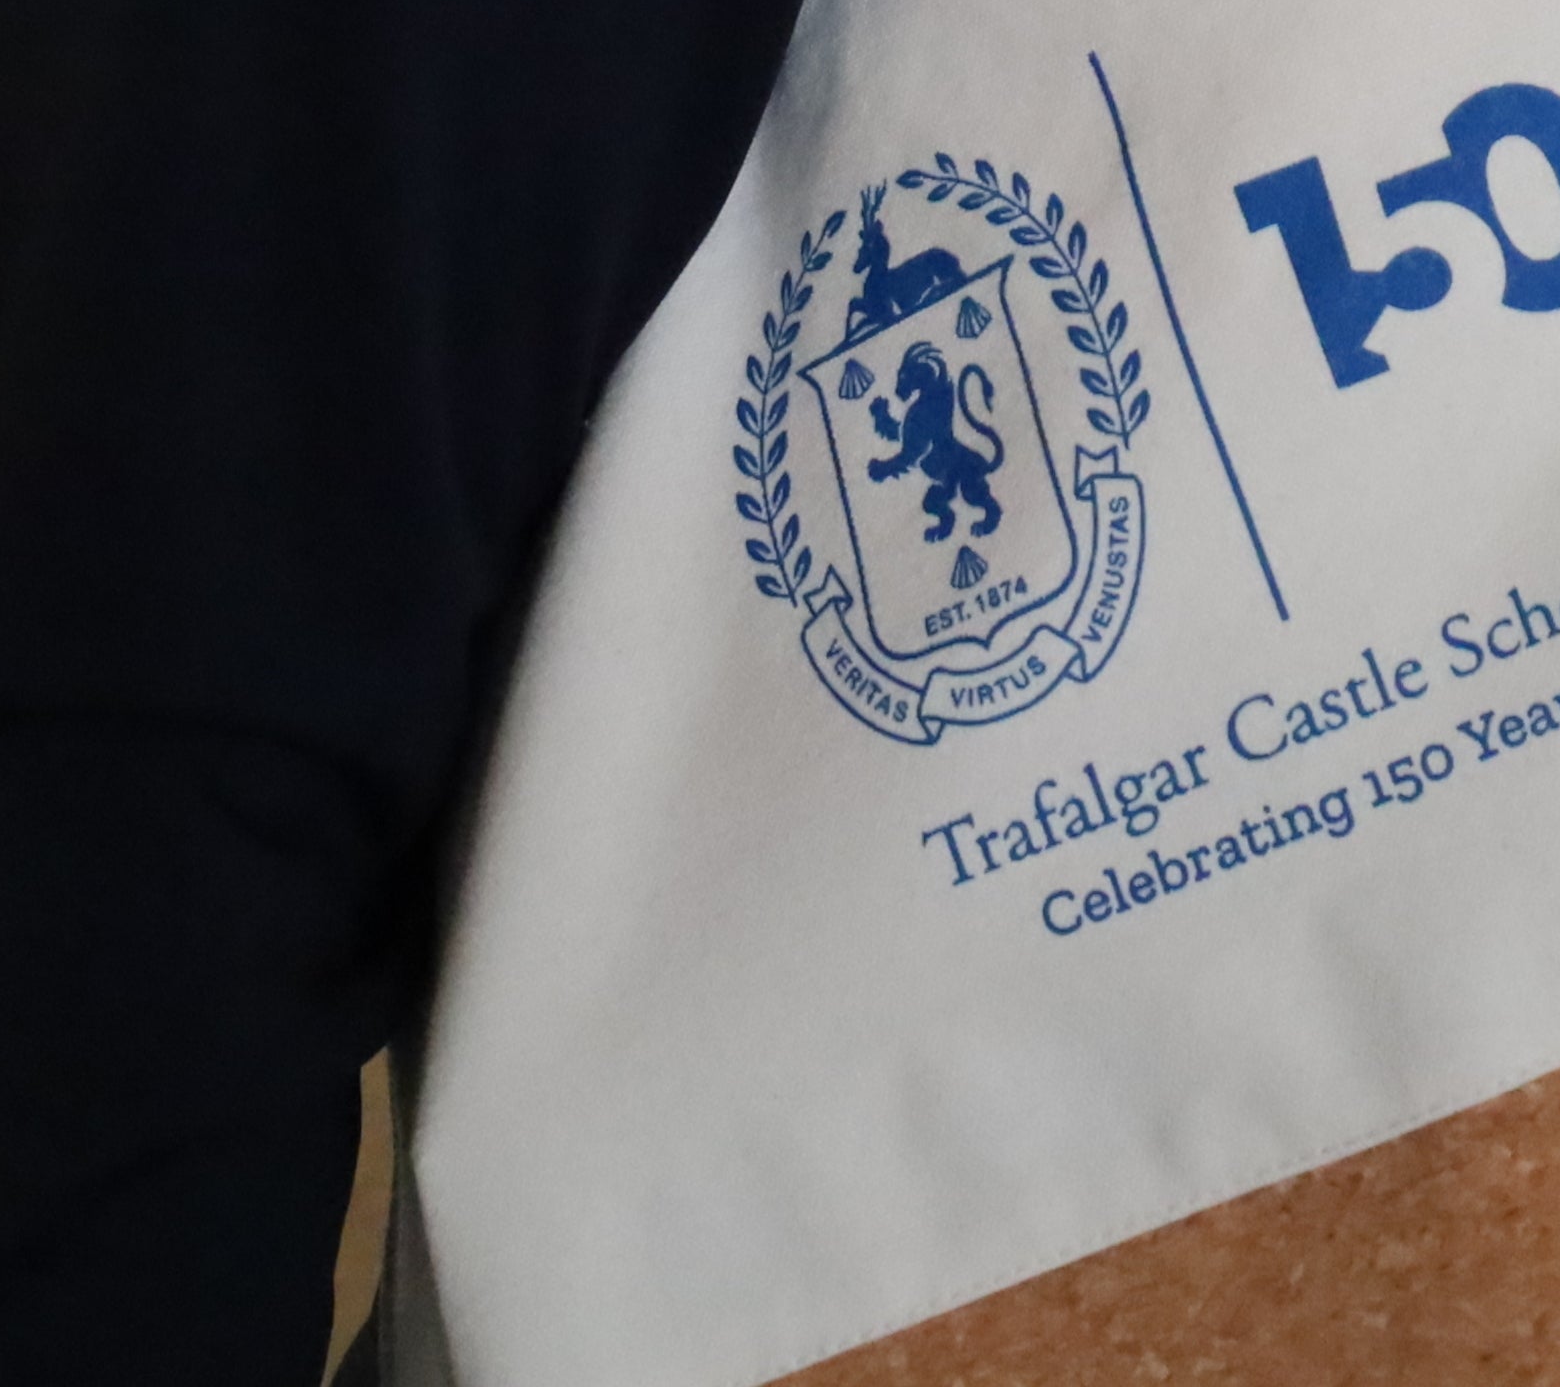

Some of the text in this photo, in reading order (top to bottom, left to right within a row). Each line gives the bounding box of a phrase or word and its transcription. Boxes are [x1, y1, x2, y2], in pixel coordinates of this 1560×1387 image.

[924, 577, 1029, 636] EST. 1874
[1082, 495, 1129, 644] VENUSTAS
[824, 638, 909, 724] VERITAS
[950, 655, 1047, 709] VIRTUS
[921, 746, 1208, 886] Trafalgar
[1227, 649, 1429, 761] Castle
[1042, 788, 1355, 936] Celebrating
[1360, 742, 1455, 809] 150
